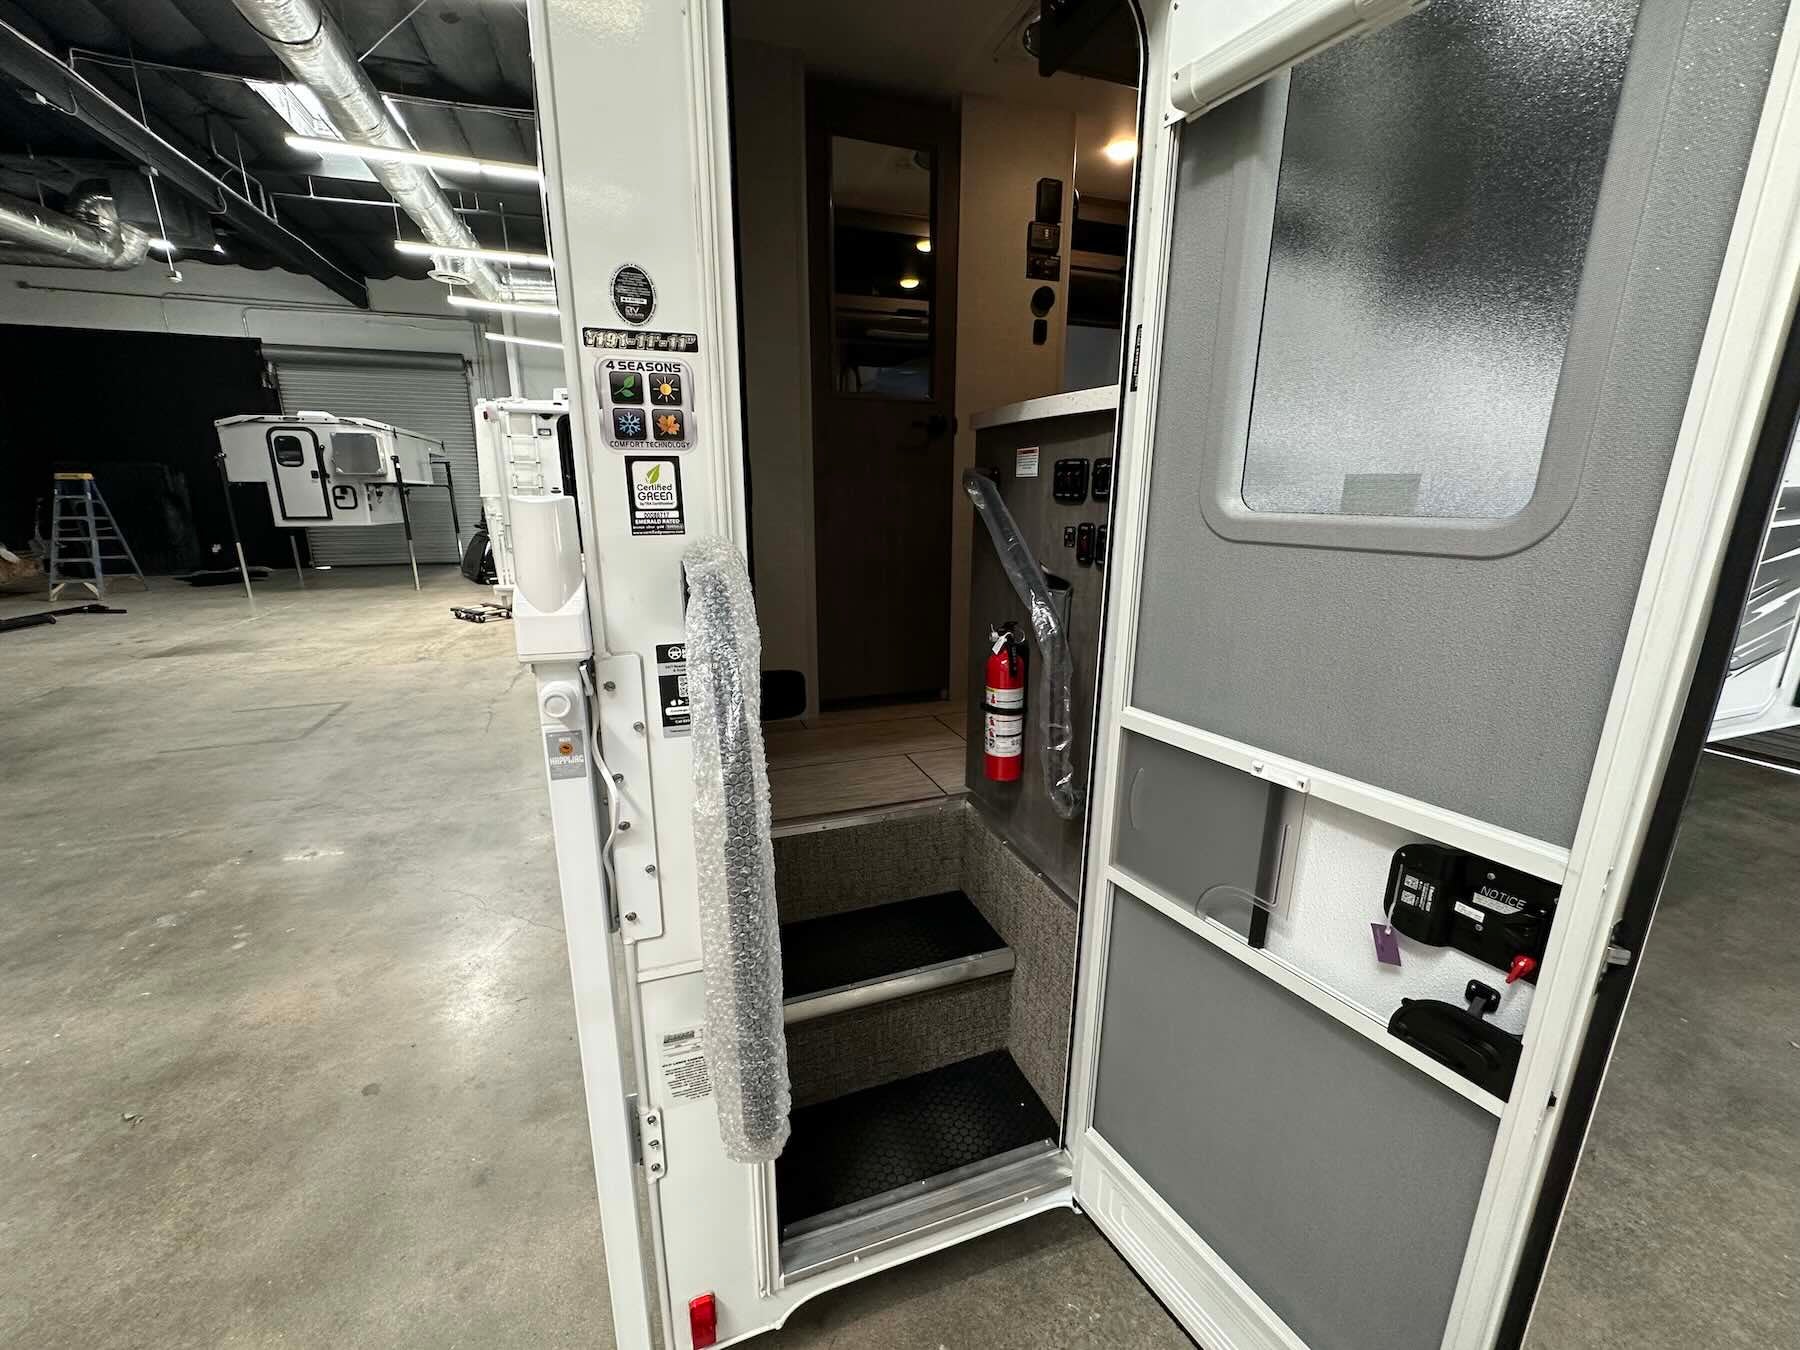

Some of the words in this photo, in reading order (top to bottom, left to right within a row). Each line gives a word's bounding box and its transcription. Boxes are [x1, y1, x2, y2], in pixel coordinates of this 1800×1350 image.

[605, 360, 615, 370] 4
[618, 361, 681, 373] SEASONS
[609, 440, 643, 448] COMFORT
[646, 440, 691, 449] TECHNOLOGY
[636, 483, 672, 491] Certified
[637, 491, 673, 501] GREEN
[1480, 885, 1527, 910] NOTICE
